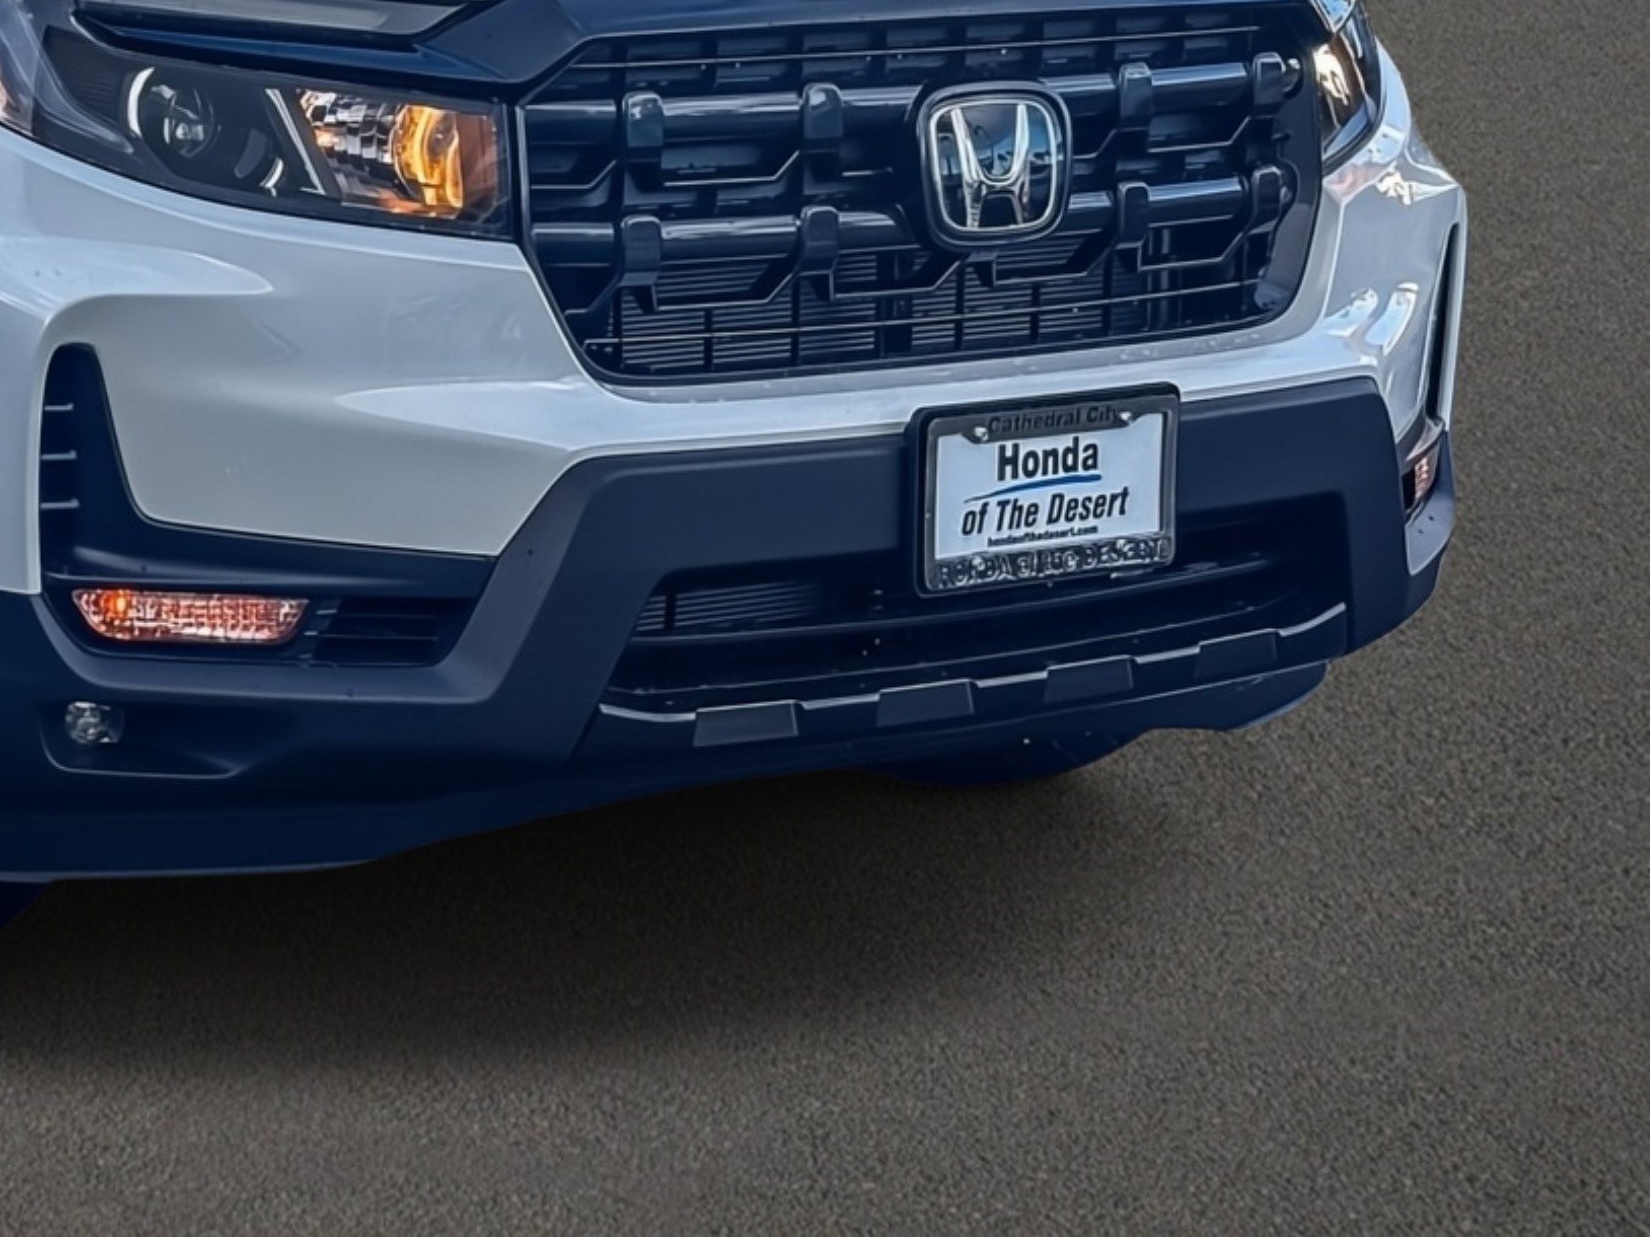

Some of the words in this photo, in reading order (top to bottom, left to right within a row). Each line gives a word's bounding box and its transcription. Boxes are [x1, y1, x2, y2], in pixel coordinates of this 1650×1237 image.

[989, 407, 1081, 433] Cathedral
[997, 436, 1098, 481] Honda
[961, 502, 990, 536] of
[996, 497, 1039, 531] The
[1046, 486, 1130, 525] Desert
